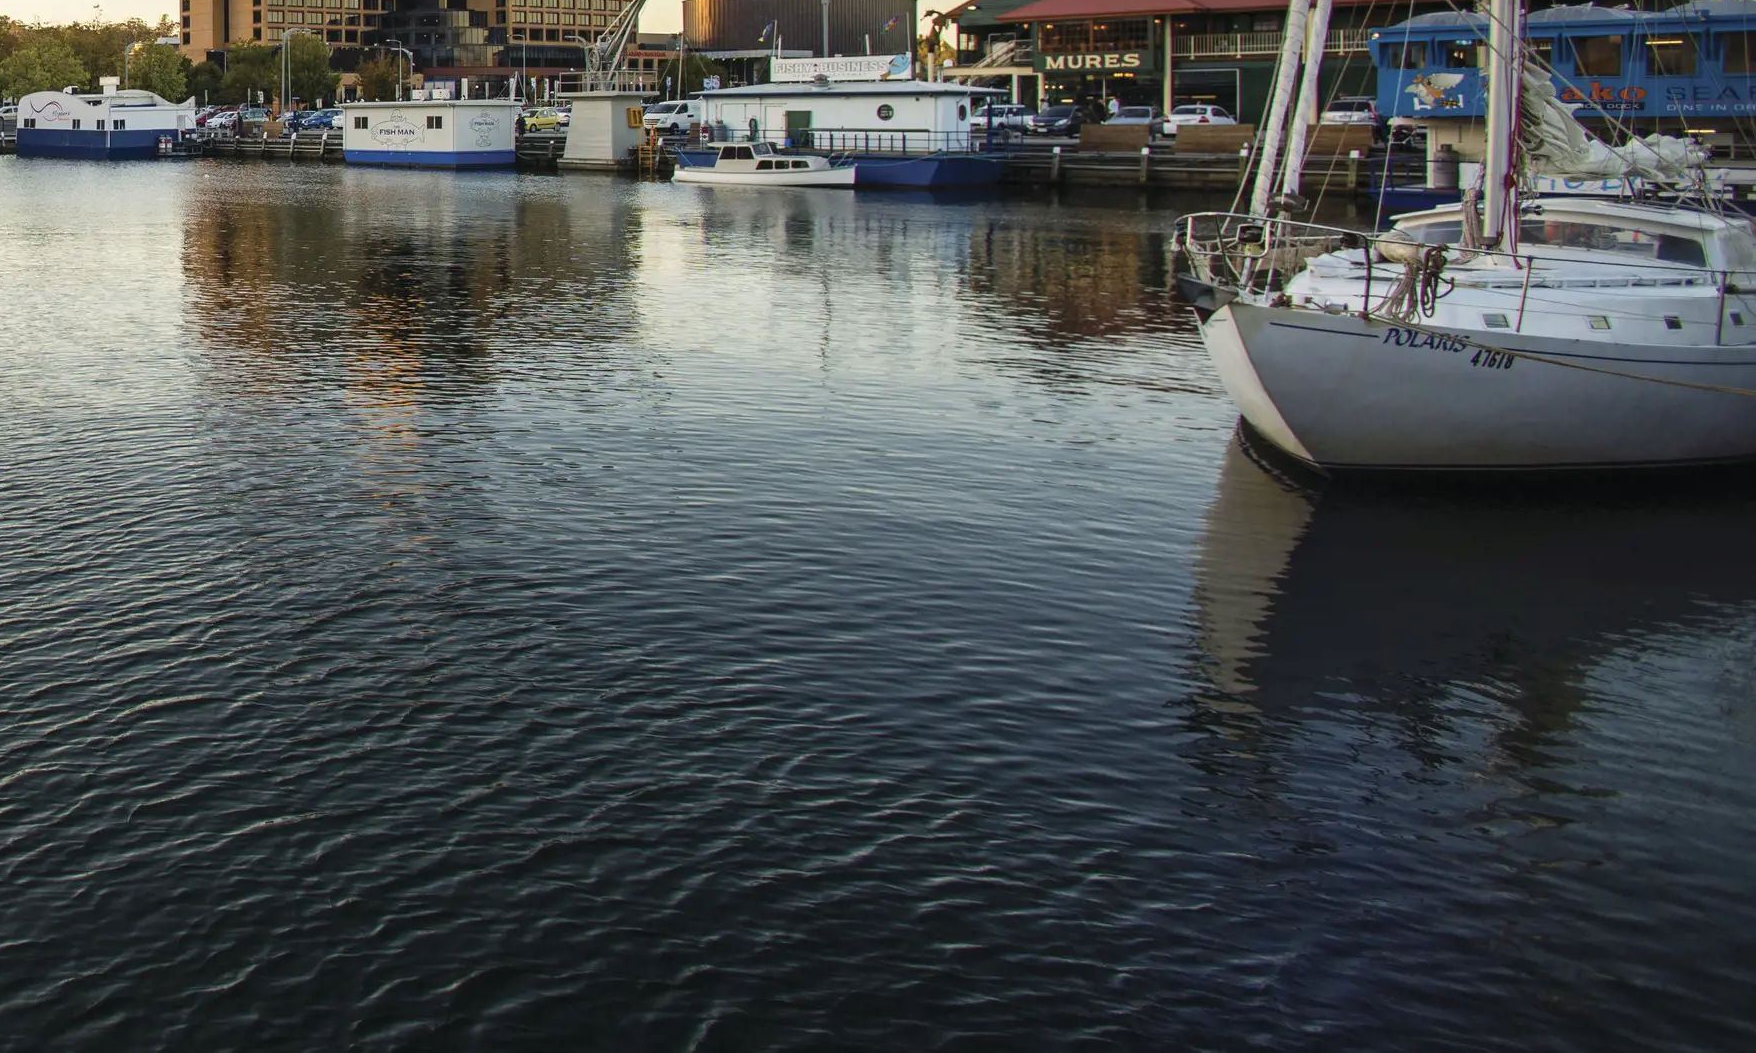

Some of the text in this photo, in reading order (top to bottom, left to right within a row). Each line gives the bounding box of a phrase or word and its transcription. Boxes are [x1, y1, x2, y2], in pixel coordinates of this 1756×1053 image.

[774, 60, 889, 74] FISHY BUSINESS
[1045, 49, 1141, 70] MURES
[1710, 103, 1727, 111] IN
[1383, 327, 1471, 353] POLARIS
